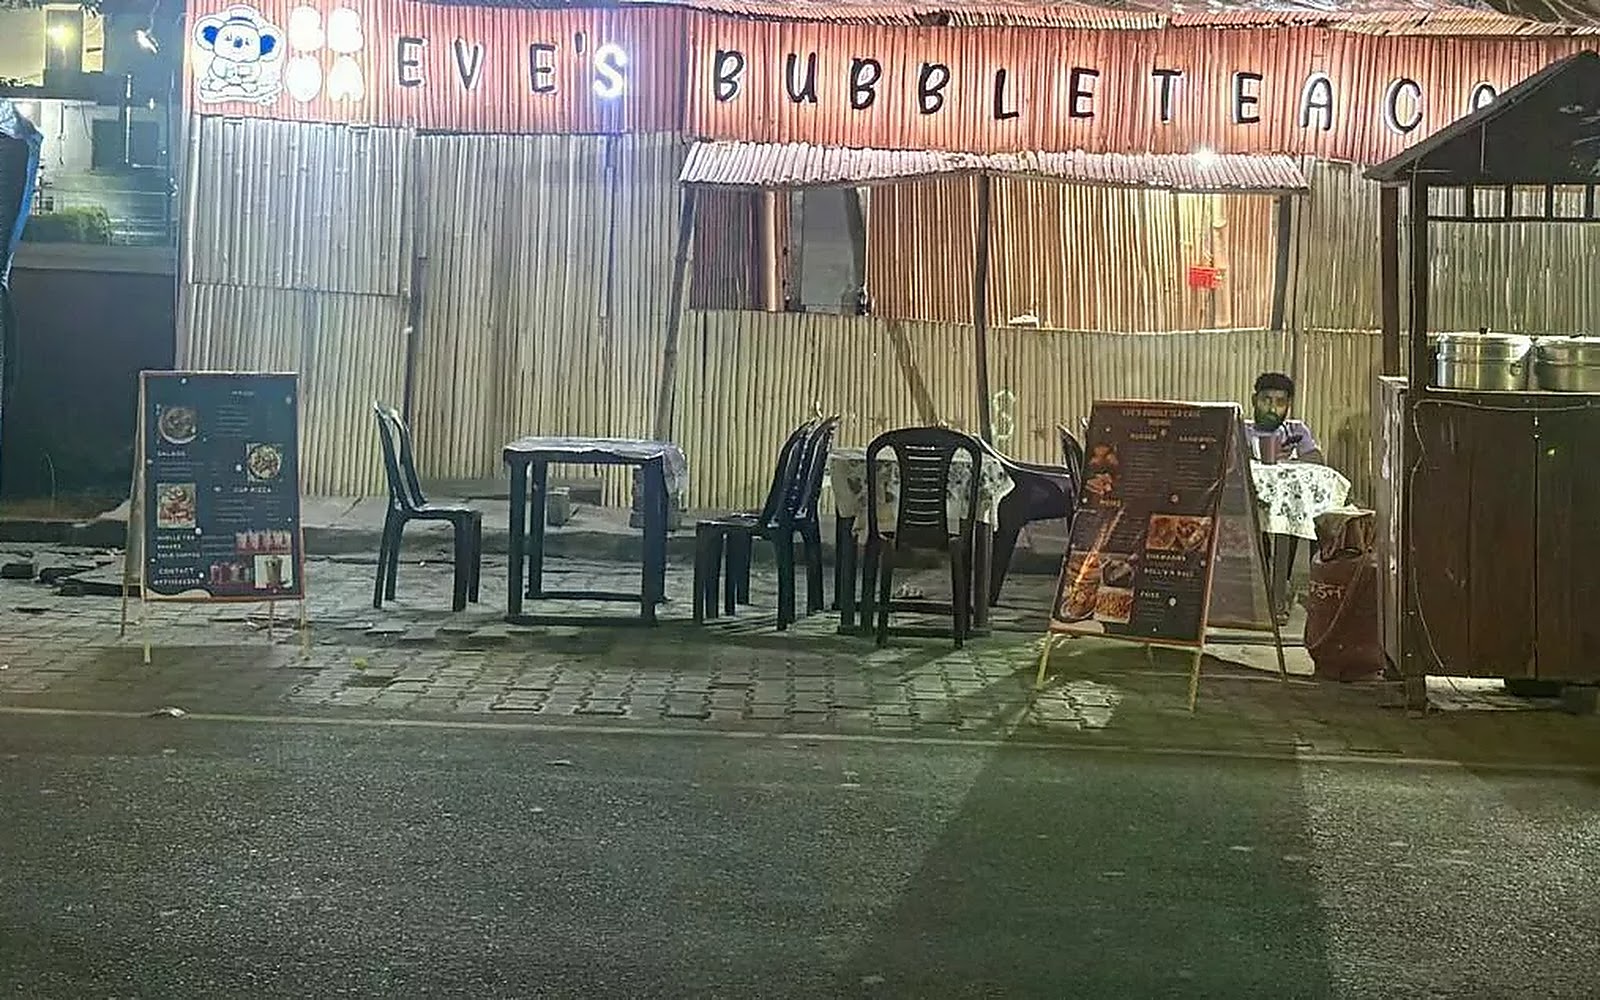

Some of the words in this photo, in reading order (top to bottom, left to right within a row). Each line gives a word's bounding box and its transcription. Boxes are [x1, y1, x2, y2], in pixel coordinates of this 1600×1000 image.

[397, 31, 628, 98] EVE'S
[712, 49, 1100, 118] BUBBLE
[1151, 69, 1334, 132] TEA
